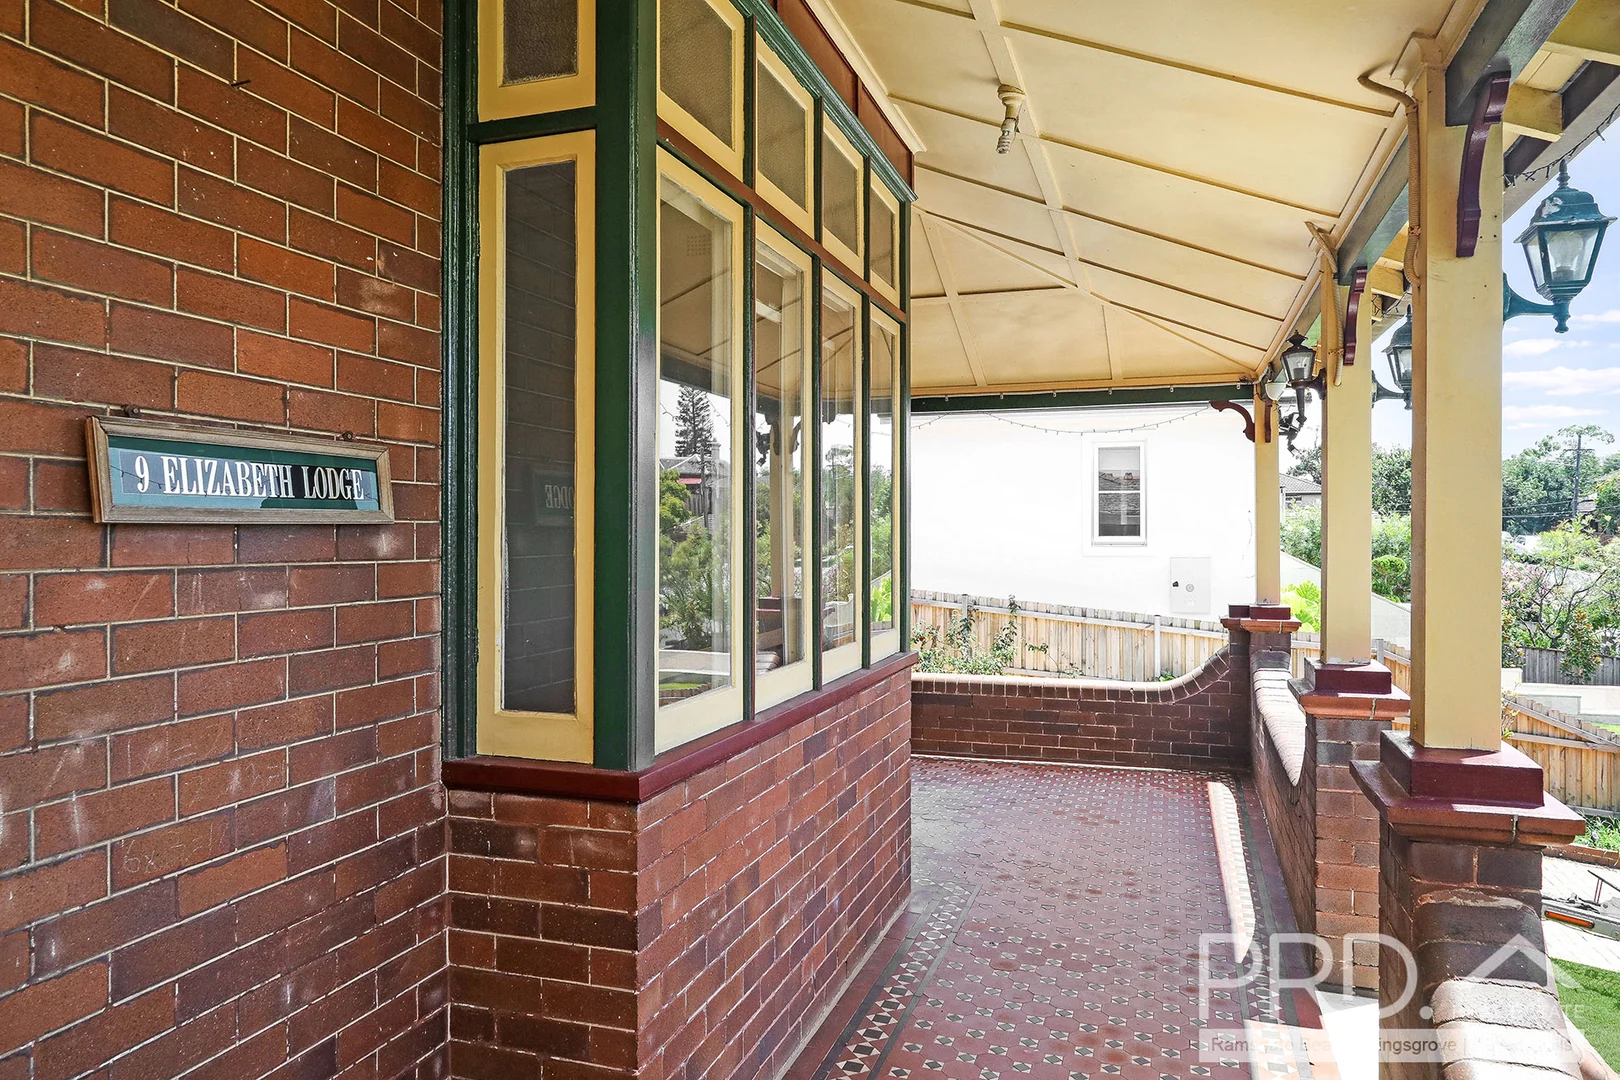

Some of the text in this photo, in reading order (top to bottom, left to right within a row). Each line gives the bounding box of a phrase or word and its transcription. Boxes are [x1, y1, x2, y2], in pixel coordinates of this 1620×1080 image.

[134, 455, 366, 501] 9 ELIZABETH LODGE
